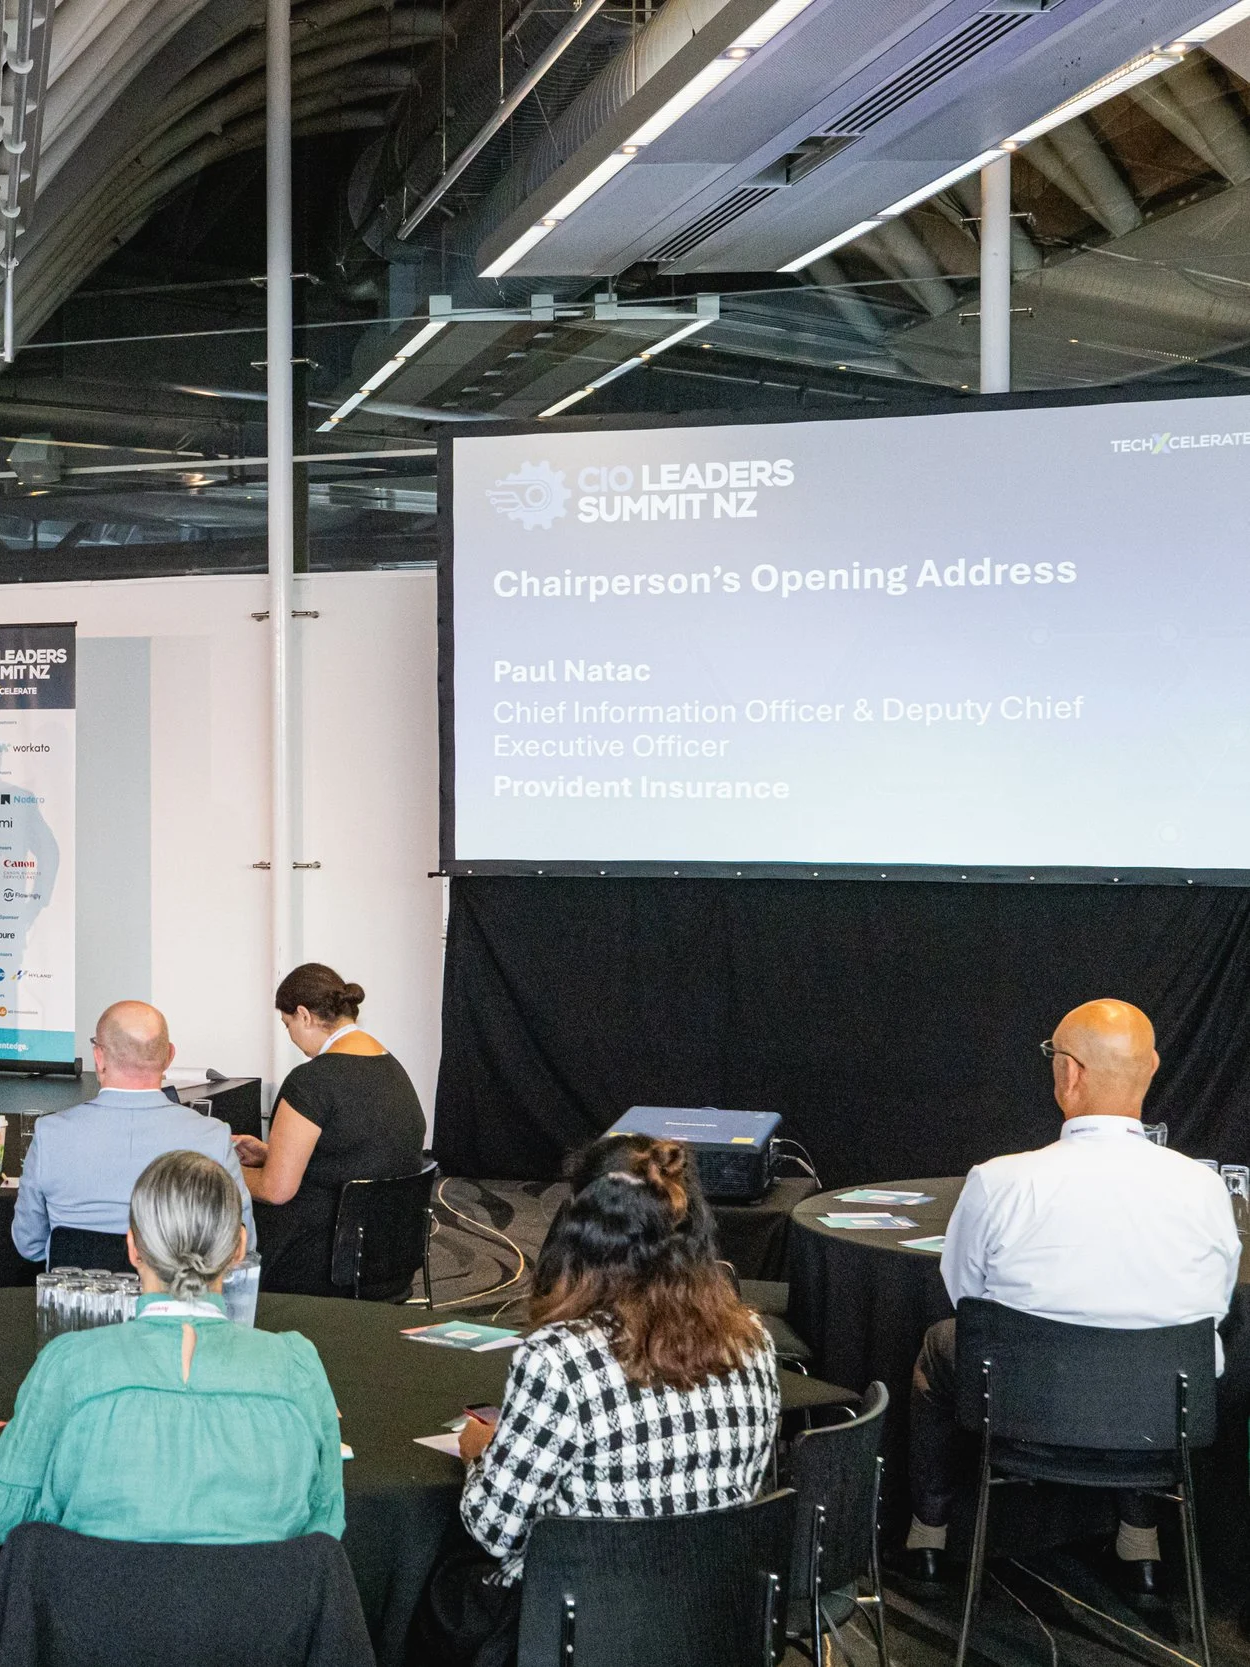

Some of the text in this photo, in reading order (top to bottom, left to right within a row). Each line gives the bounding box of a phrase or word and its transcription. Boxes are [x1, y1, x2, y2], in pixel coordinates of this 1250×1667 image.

[578, 459, 795, 493] CIO LEADERS
[577, 491, 758, 523] SUMMIT NZ
[751, 561, 908, 598] Opening
[916, 557, 1077, 588] Address
[29, 665, 50, 679] NZ
[494, 659, 651, 683] Paul Natac
[493, 695, 1084, 726] Chief Information Officer & Deputy Chief
[13, 743, 50, 753] workato
[494, 733, 730, 758] Executive Officer
[494, 775, 790, 799] Provident Insurance
[3, 860, 35, 868] Canon
